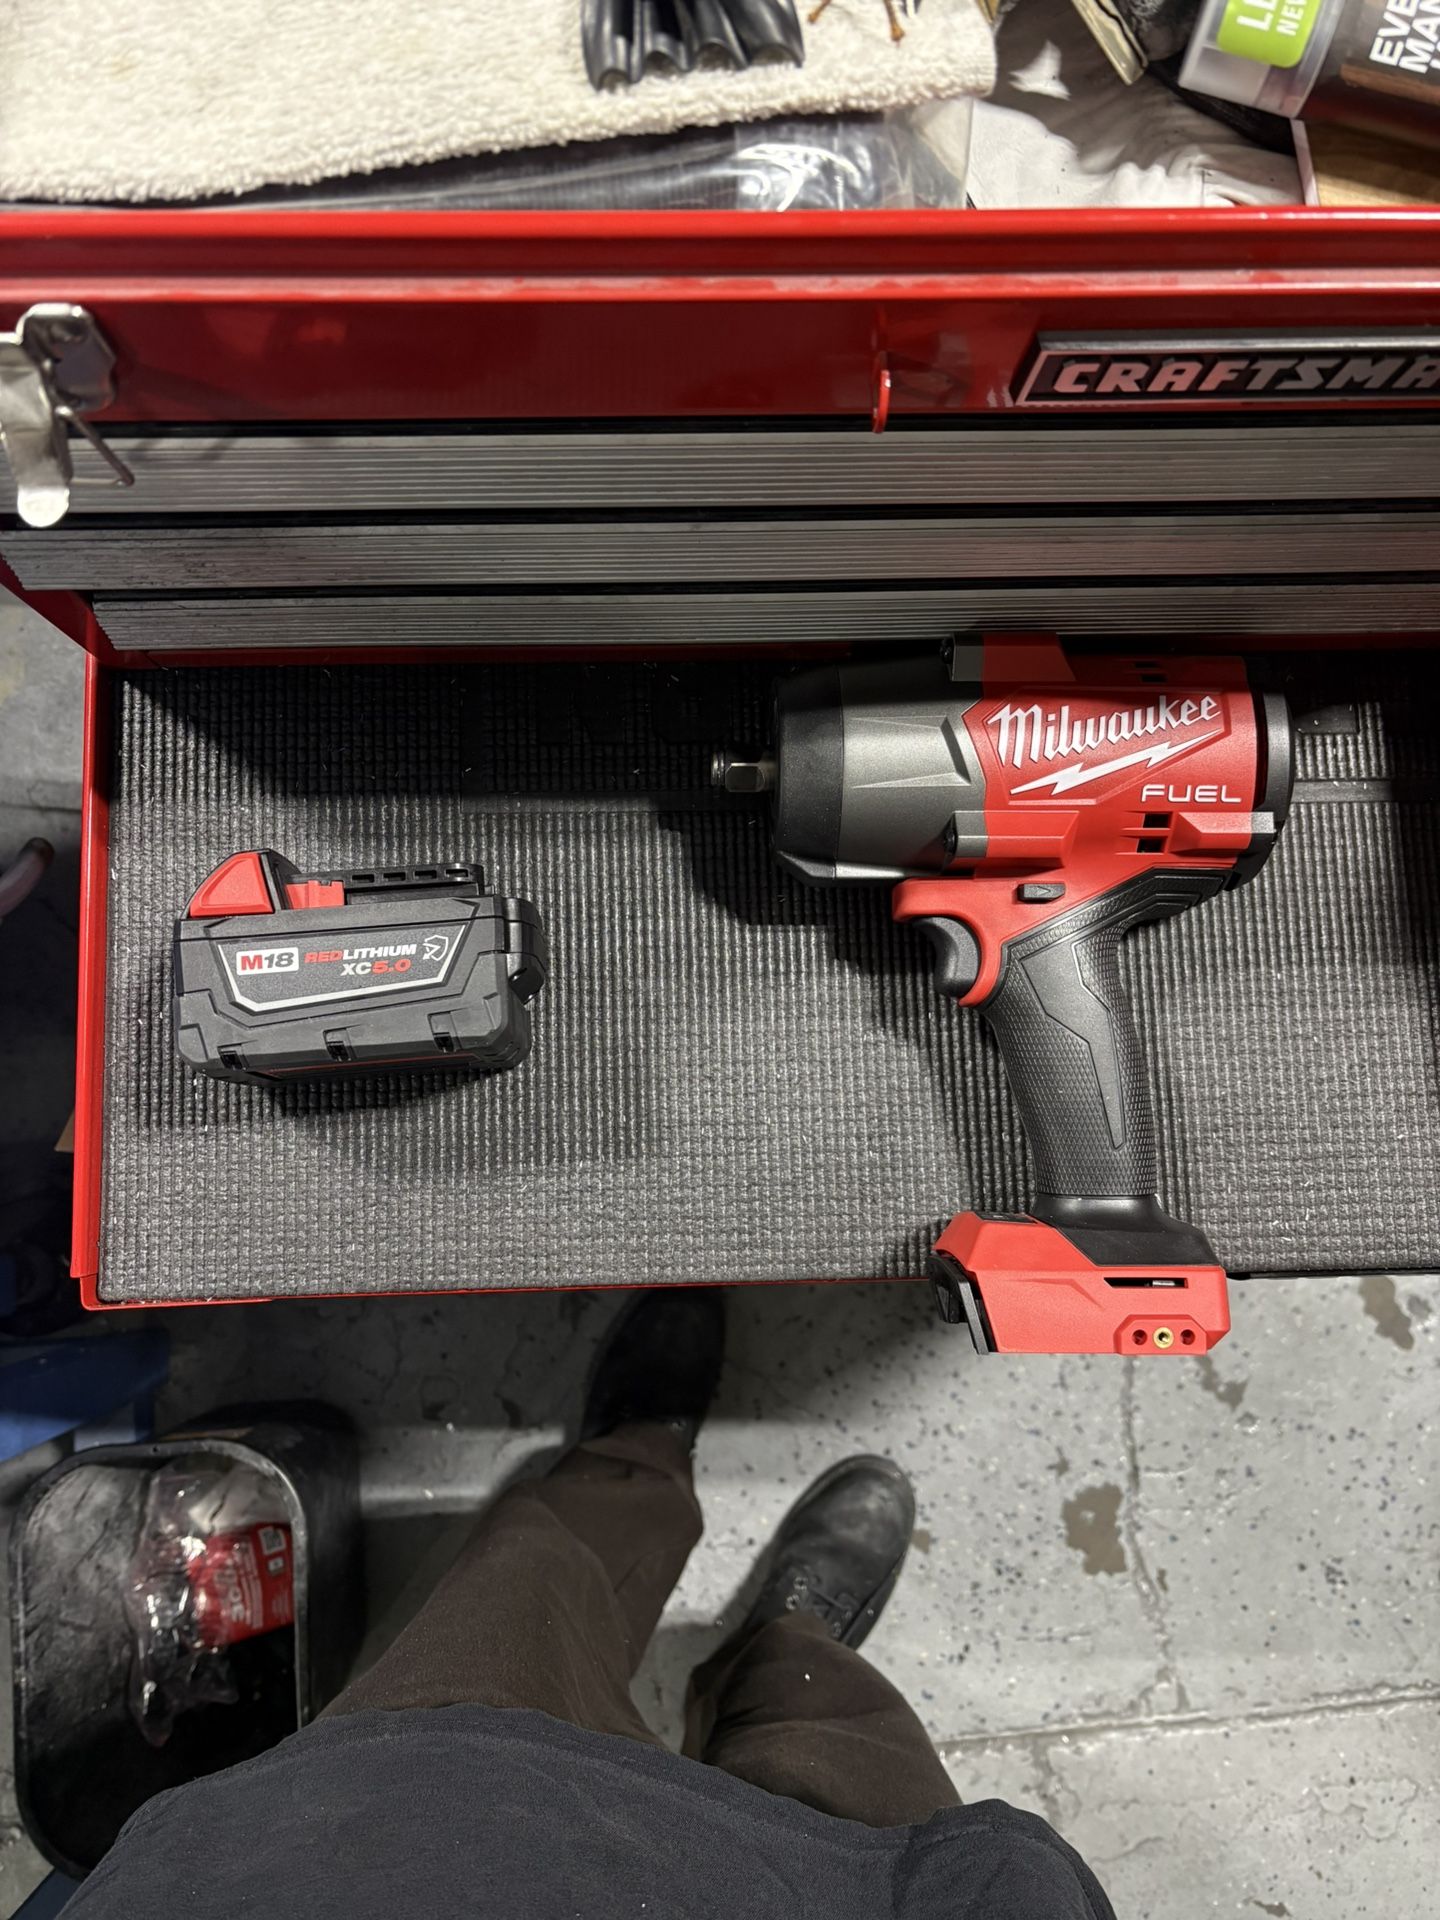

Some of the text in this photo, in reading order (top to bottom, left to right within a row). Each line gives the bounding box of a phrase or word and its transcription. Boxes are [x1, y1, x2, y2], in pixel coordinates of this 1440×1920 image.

[987, 695, 1222, 769] Milwaukee
[1141, 784, 1242, 803] FUEL
[240, 944, 417, 971] M18 REDLITHIUM
[340, 958, 412, 976] XC5.0
